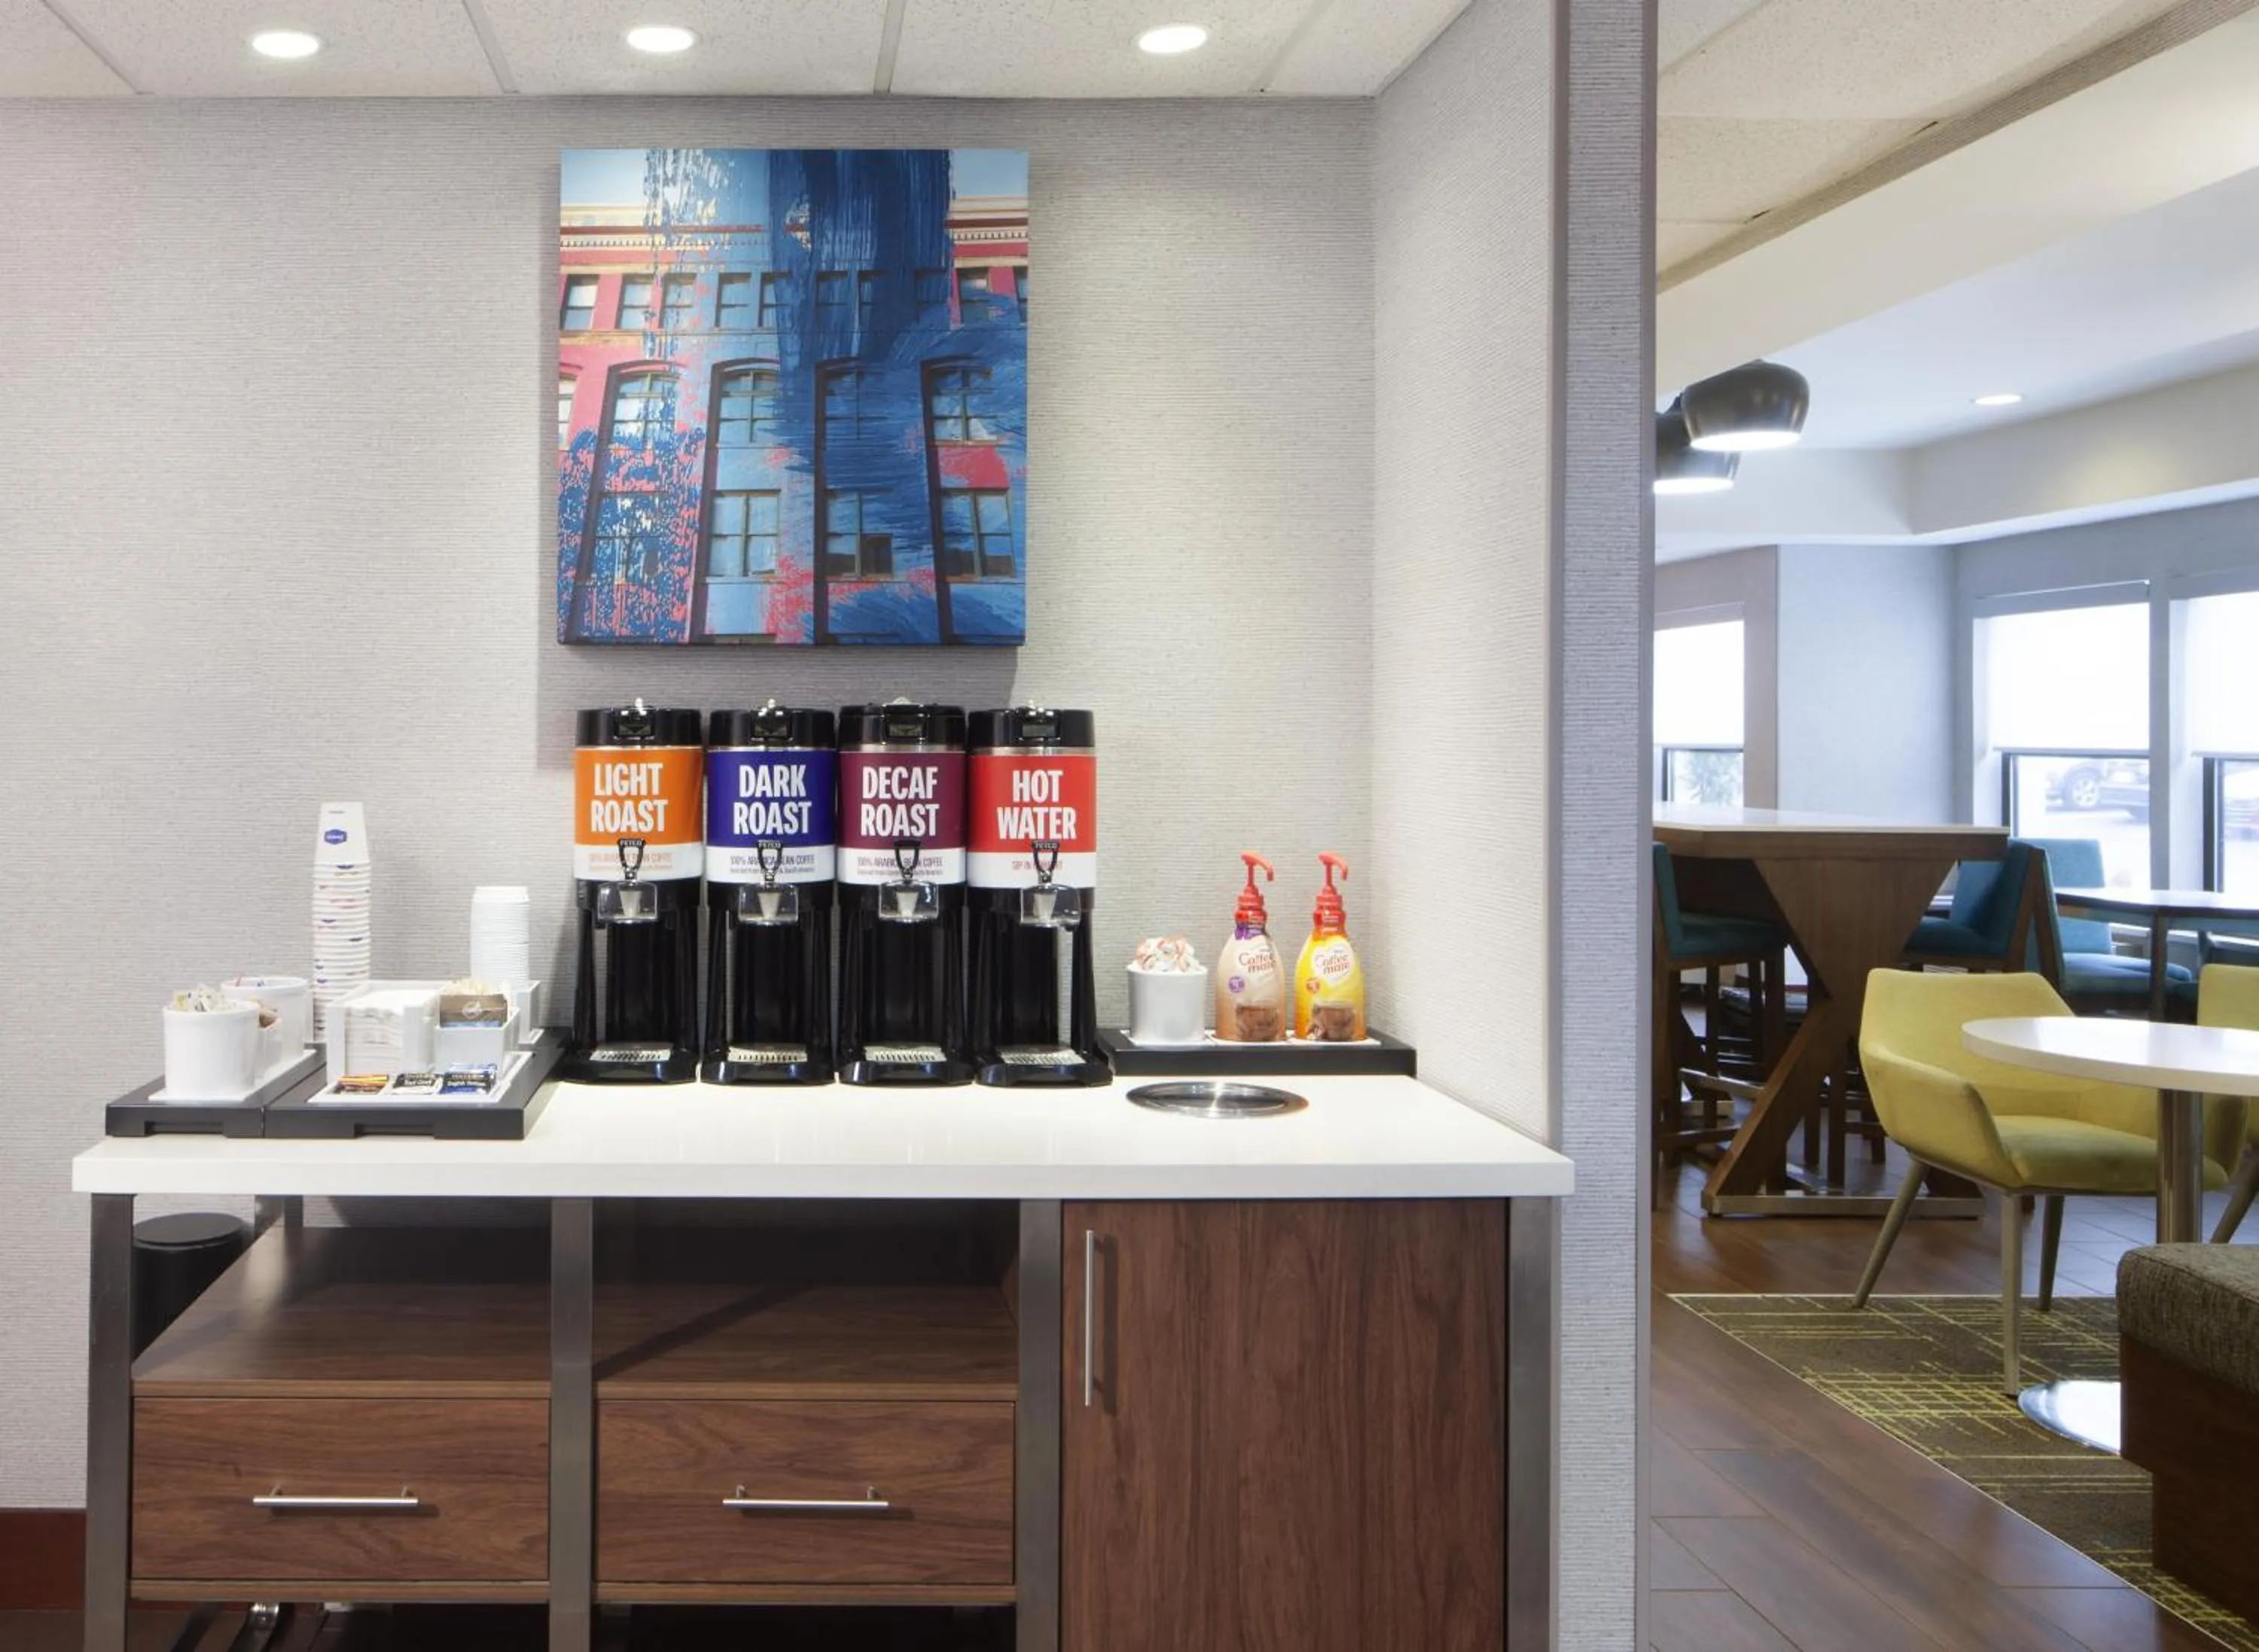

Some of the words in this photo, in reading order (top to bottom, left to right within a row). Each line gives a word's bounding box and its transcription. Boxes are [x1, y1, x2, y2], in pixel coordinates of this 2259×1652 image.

[593, 763, 663, 797] LIGHT
[739, 764, 806, 798] DARK
[862, 767, 938, 800] DECAF
[1012, 770, 1064, 803] HOT
[590, 799, 669, 833] ROAST
[733, 801, 812, 835] ROAST
[861, 803, 940, 837] ROAST
[996, 806, 1077, 840] WATER
